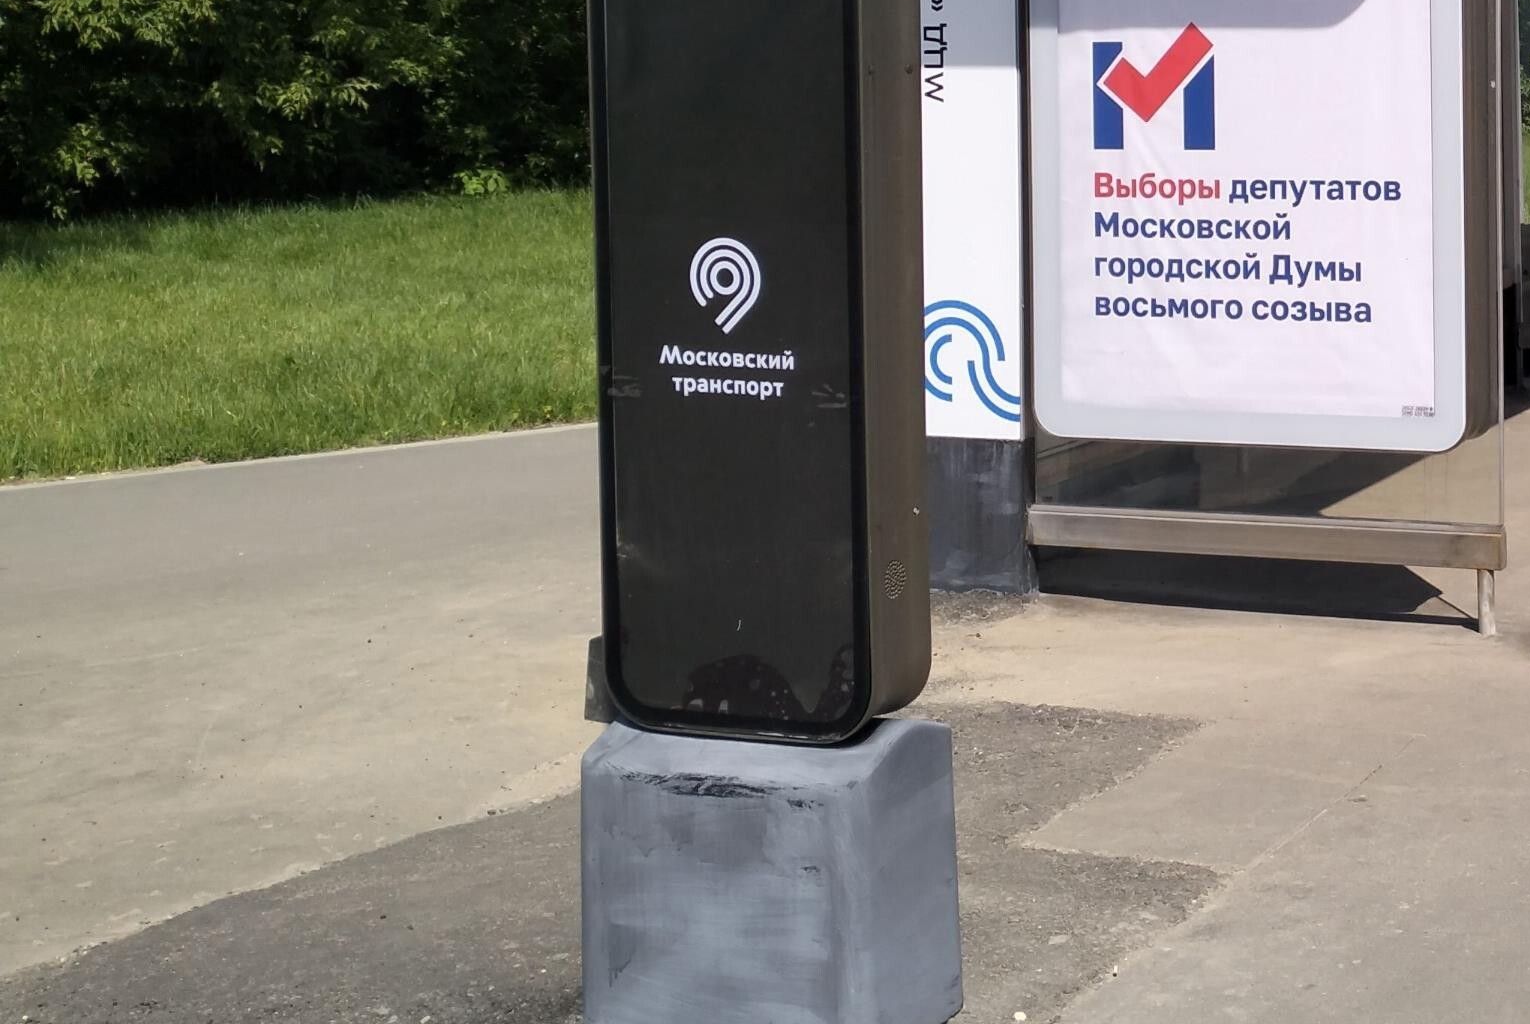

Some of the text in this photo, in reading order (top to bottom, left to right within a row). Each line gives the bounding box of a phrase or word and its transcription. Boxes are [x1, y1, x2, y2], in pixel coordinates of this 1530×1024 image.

[924, 23, 947, 102] МЦД
[1094, 172, 1402, 207] Выборы депутатов
[1094, 211, 1291, 241] Московской
[1094, 252, 1362, 290] городской Думы
[1094, 296, 1372, 323] восьмого созыва
[659, 344, 795, 371] Московский
[671, 376, 785, 401] транспорт
